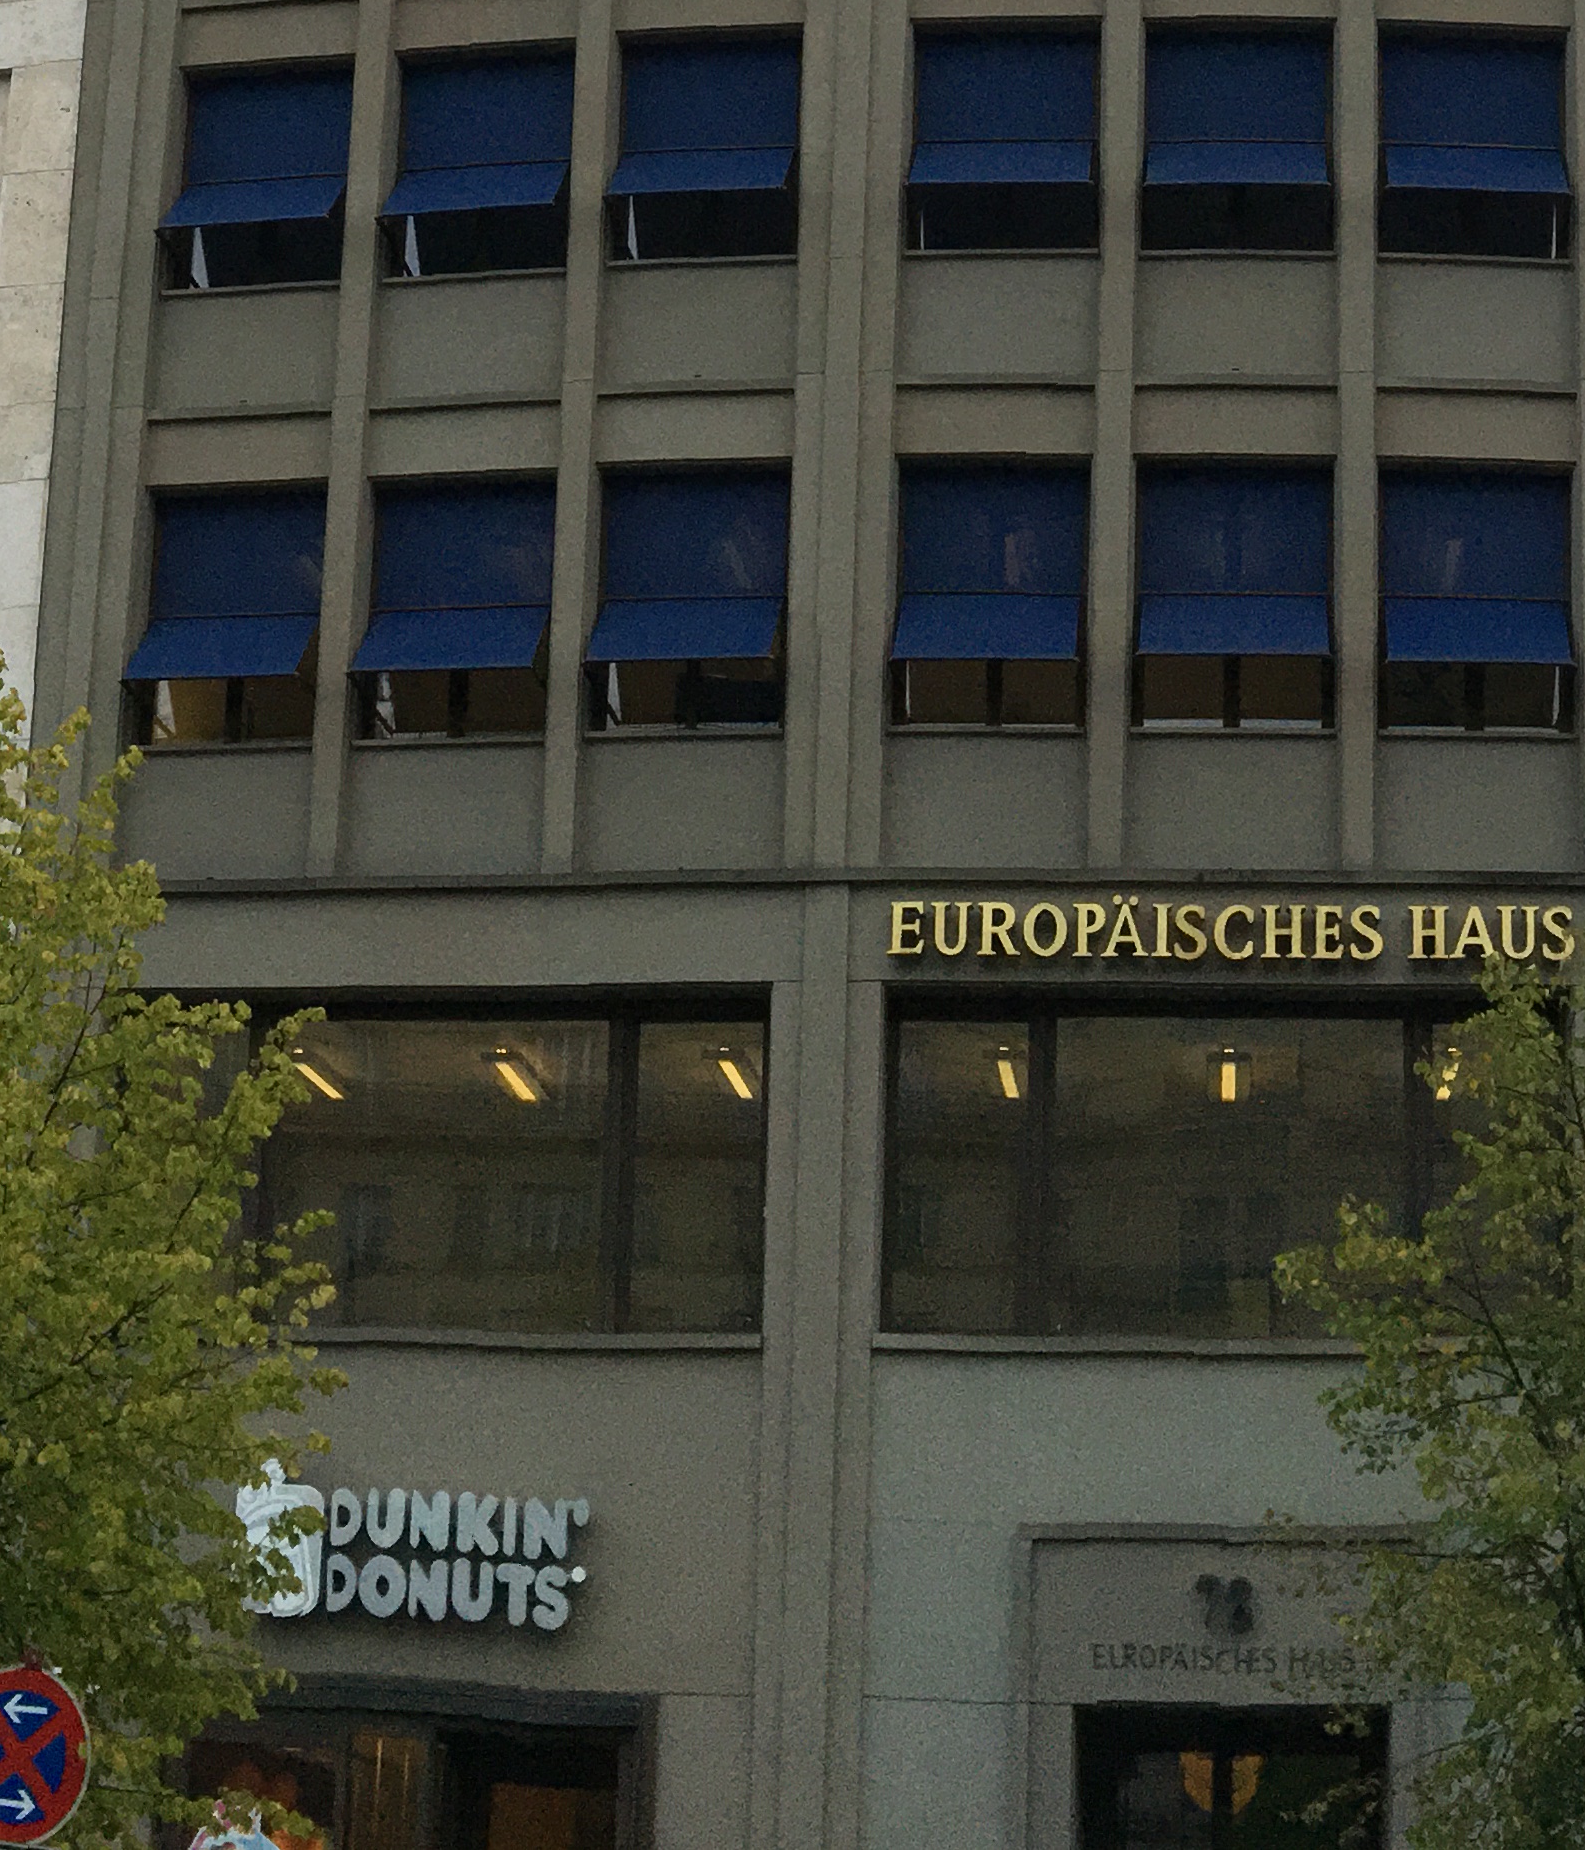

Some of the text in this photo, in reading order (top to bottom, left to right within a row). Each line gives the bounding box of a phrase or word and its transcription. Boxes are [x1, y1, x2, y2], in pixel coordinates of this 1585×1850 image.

[887, 894, 1576, 962] EUROPÄISCHES HAUS
[325, 1553, 571, 1631] DONUTS
